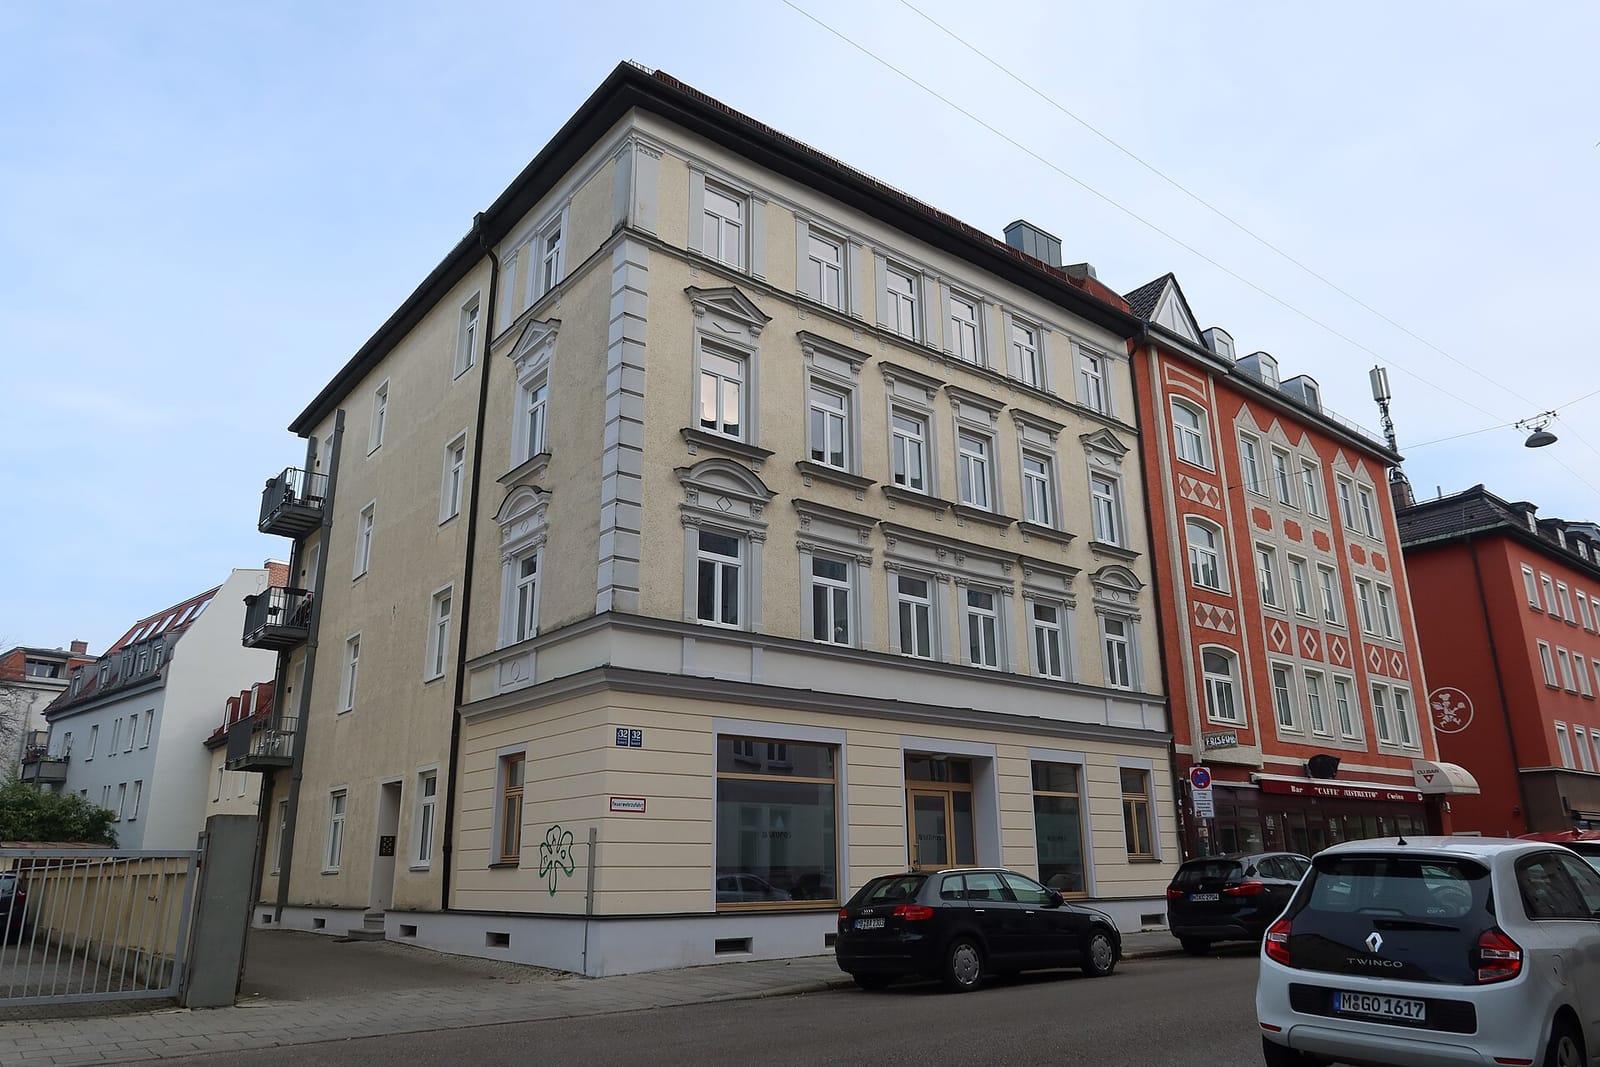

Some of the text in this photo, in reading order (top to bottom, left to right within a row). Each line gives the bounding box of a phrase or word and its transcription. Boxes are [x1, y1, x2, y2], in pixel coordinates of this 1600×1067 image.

[1290, 785, 1304, 793] Bar
[1346, 957, 1403, 968] TWINGO
[1342, 993, 1424, 1018] M GO 1617
